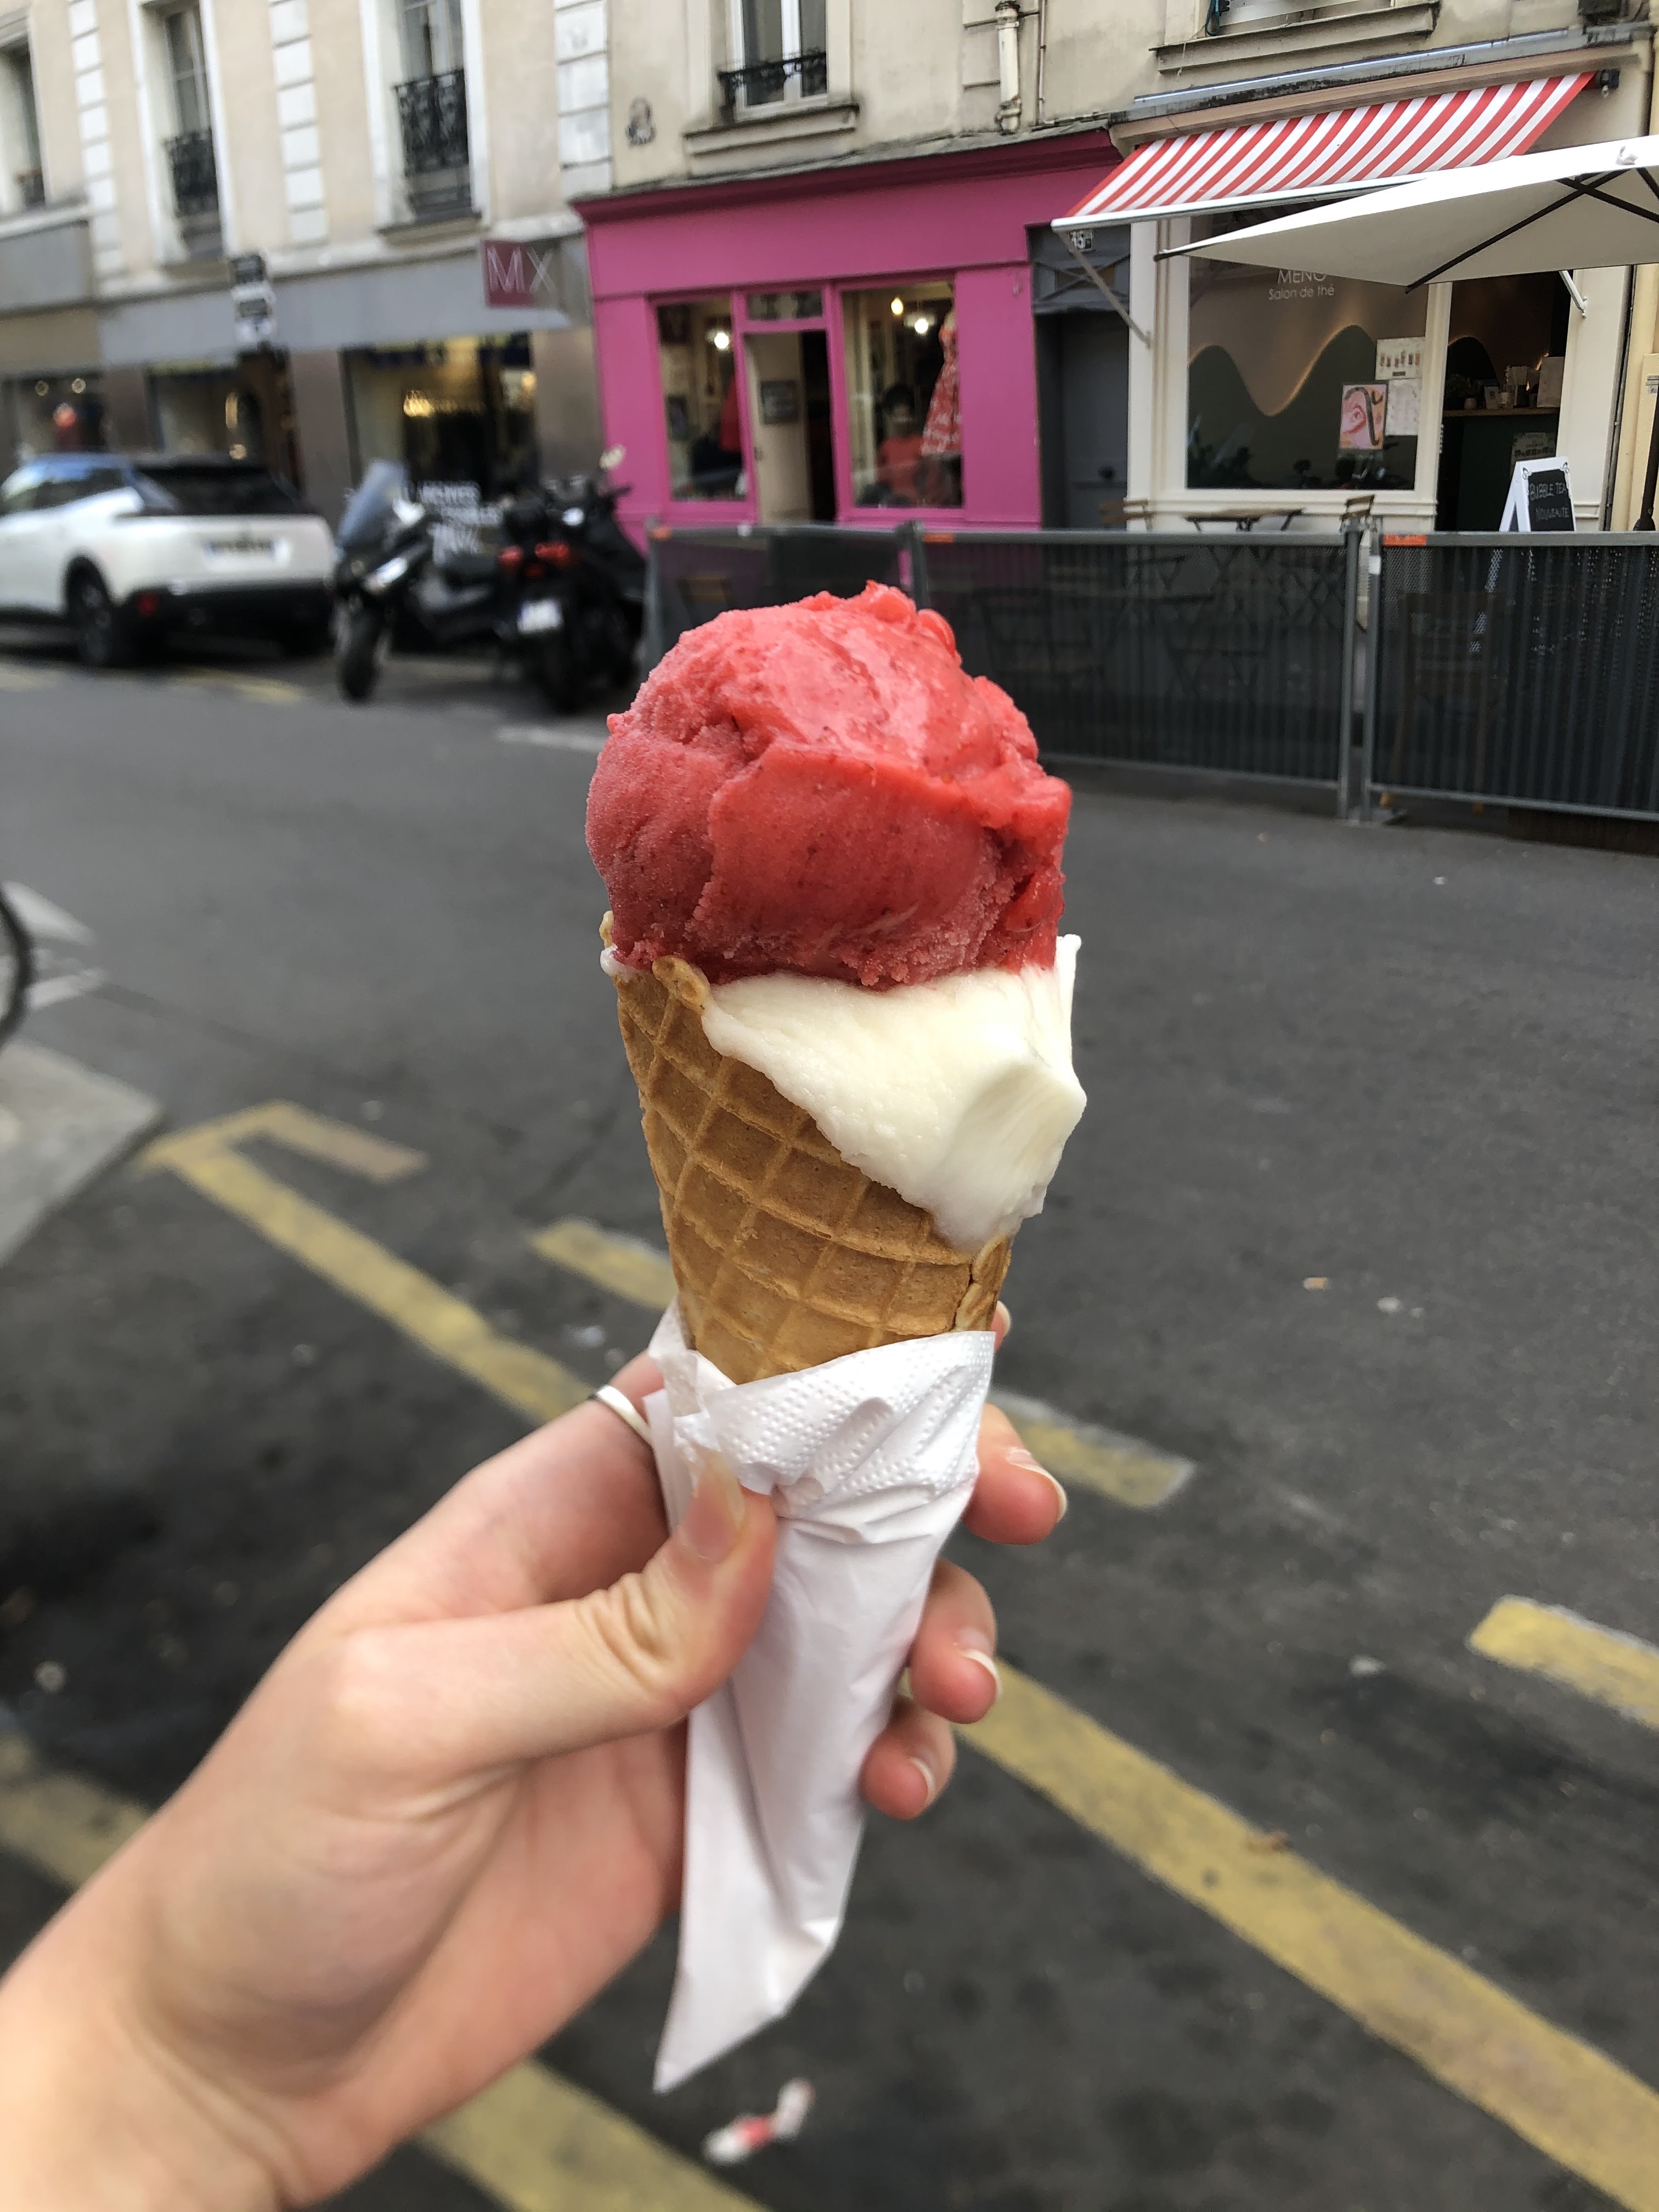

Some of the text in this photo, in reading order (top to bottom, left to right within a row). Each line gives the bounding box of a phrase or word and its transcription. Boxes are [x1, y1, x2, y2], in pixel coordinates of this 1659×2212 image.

[486, 246, 556, 293] MX
[1268, 283, 1334, 301] Salon de thé
